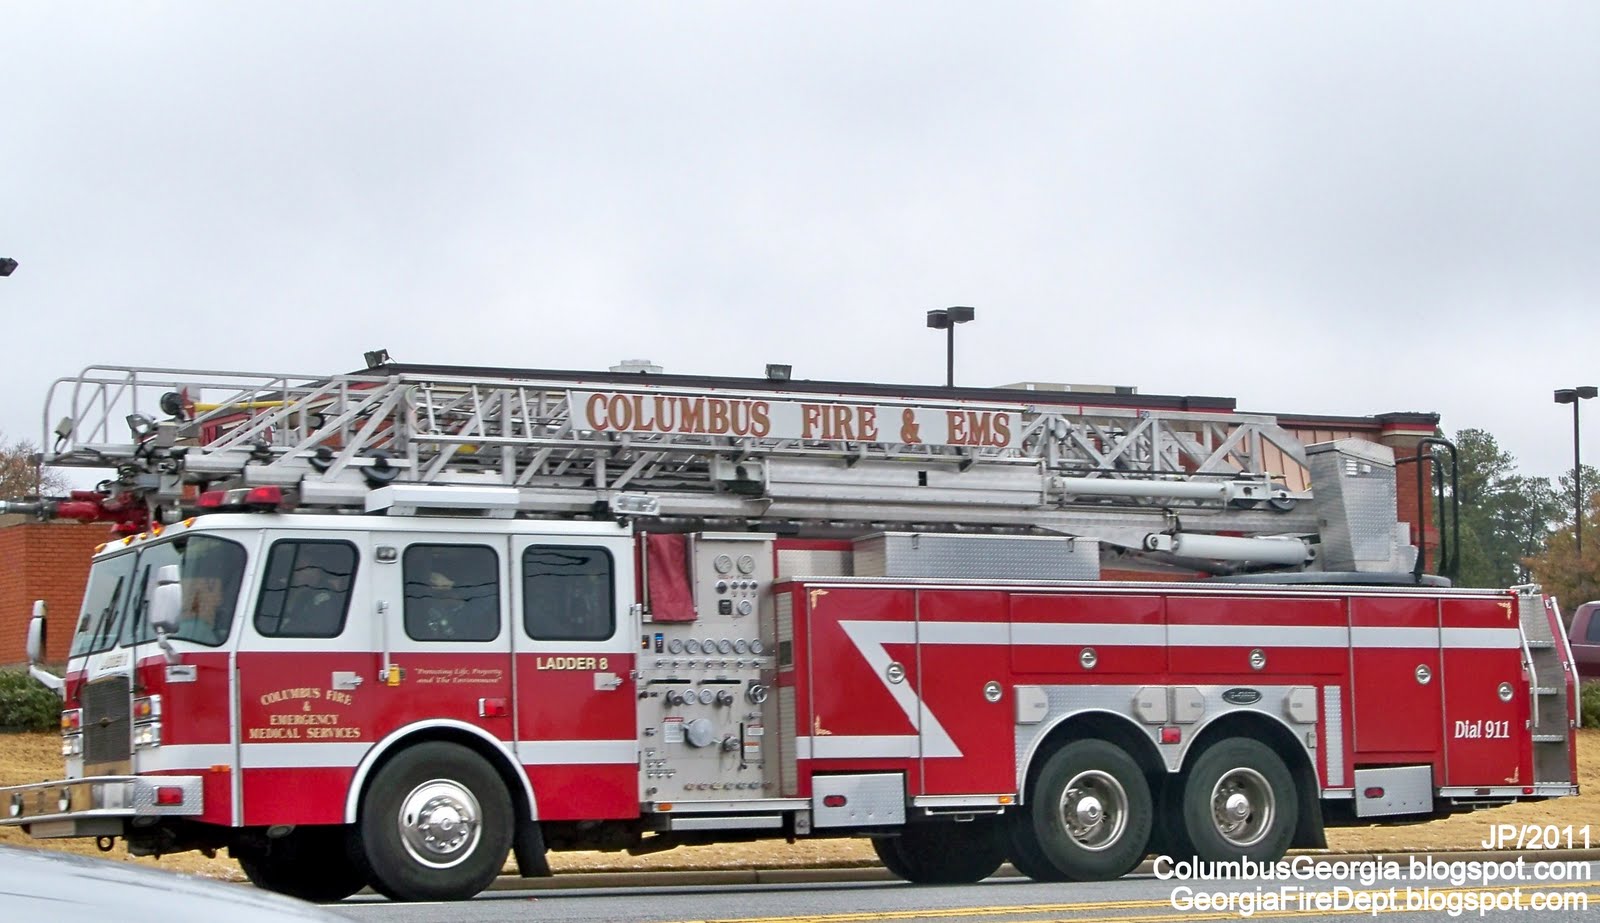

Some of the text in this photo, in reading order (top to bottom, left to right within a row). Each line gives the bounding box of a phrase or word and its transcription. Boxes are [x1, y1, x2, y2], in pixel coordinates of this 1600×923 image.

[586, 393, 1011, 447] COLUMBUS FIRE & EMS
[536, 657, 609, 671] LADDER 8
[261, 688, 352, 706] COLUMBUS FIRE
[302, 701, 312, 712] &
[270, 715, 340, 726] EMERGENCY
[249, 728, 361, 739] MEDICAL SERVICES
[1454, 720, 1510, 738] Dial 911
